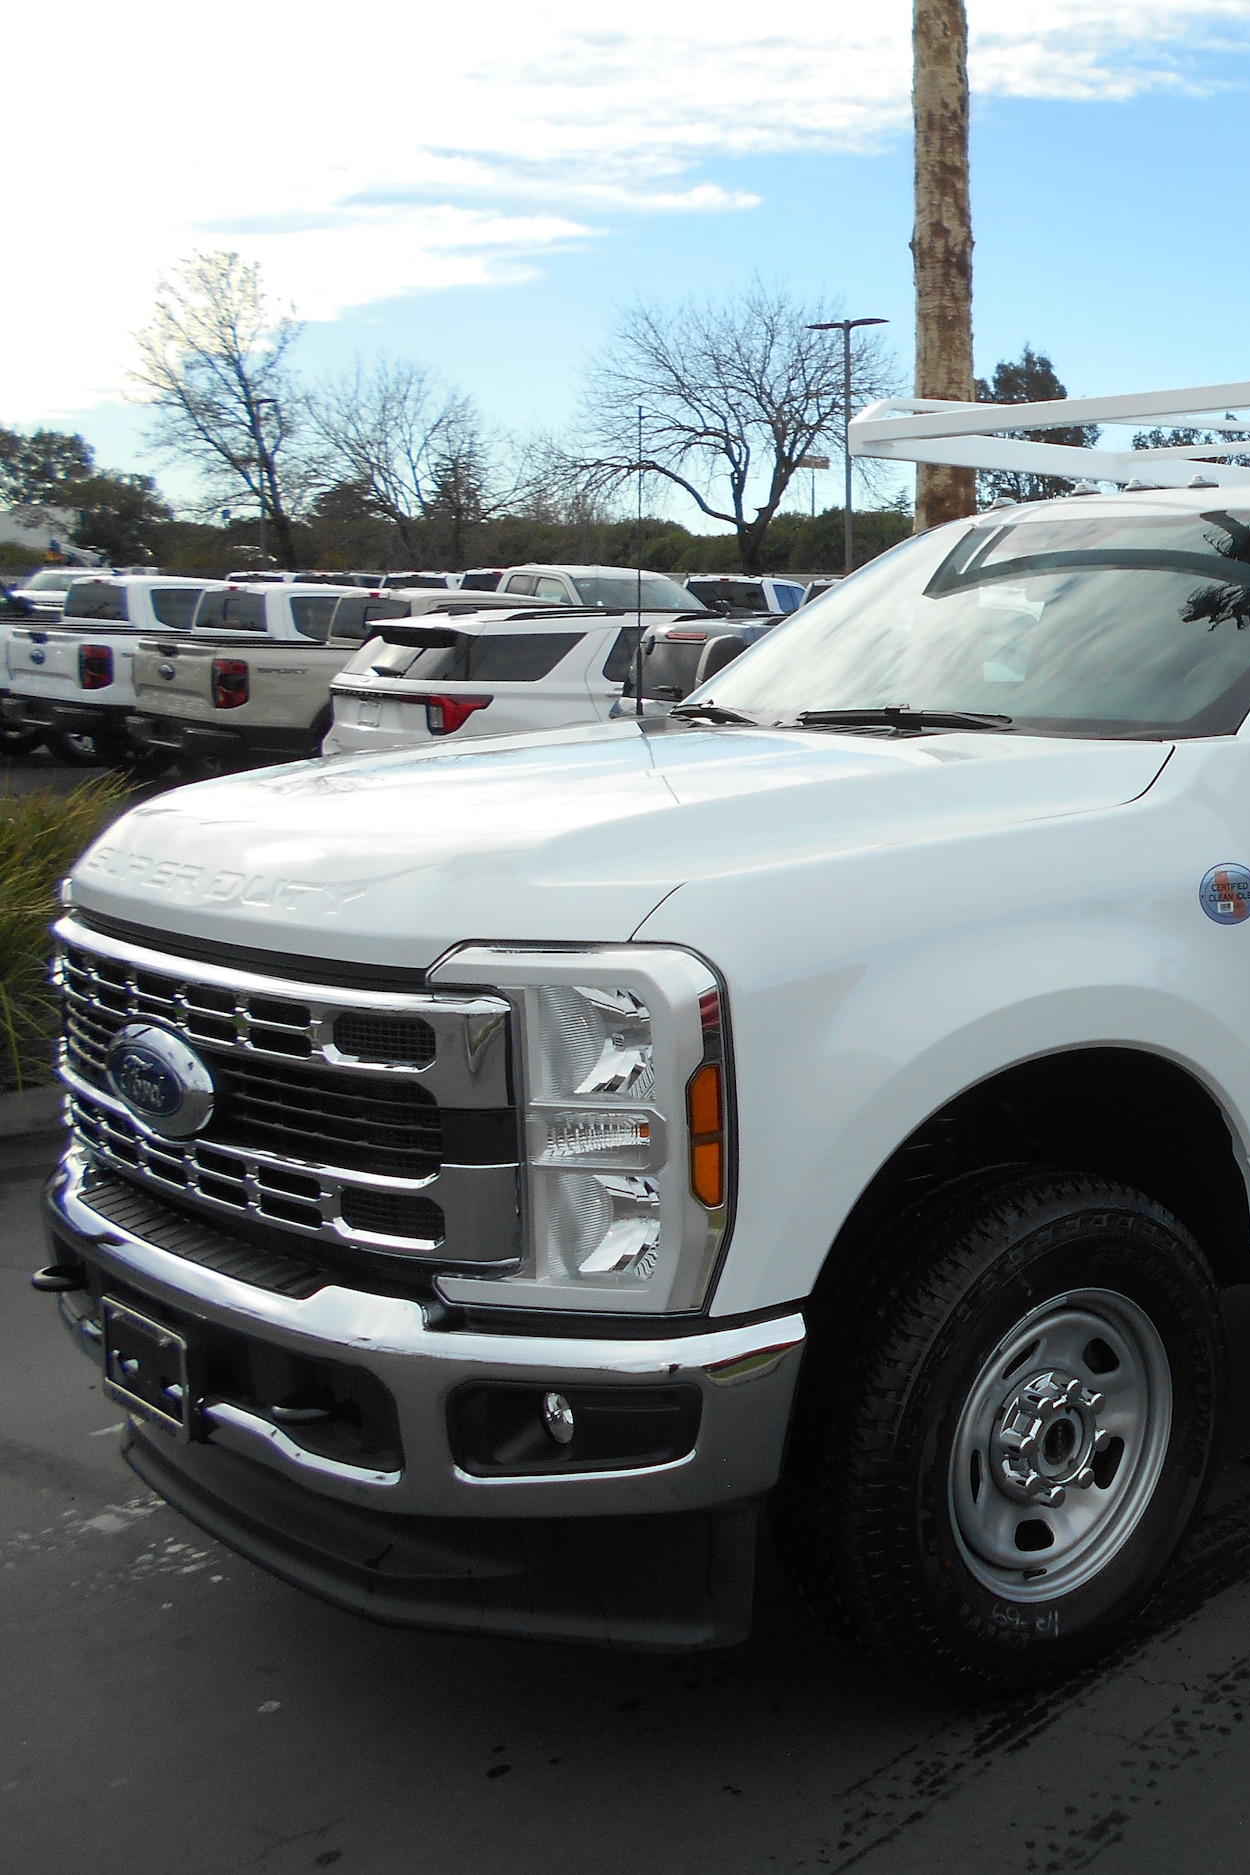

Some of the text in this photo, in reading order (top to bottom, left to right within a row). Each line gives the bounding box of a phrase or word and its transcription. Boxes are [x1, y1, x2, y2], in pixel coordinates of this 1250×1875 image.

[87, 846, 368, 916] SUPER DUTY
[1211, 882, 1249, 892] CERTIFIED
[1208, 893, 1234, 902] CLEAN
